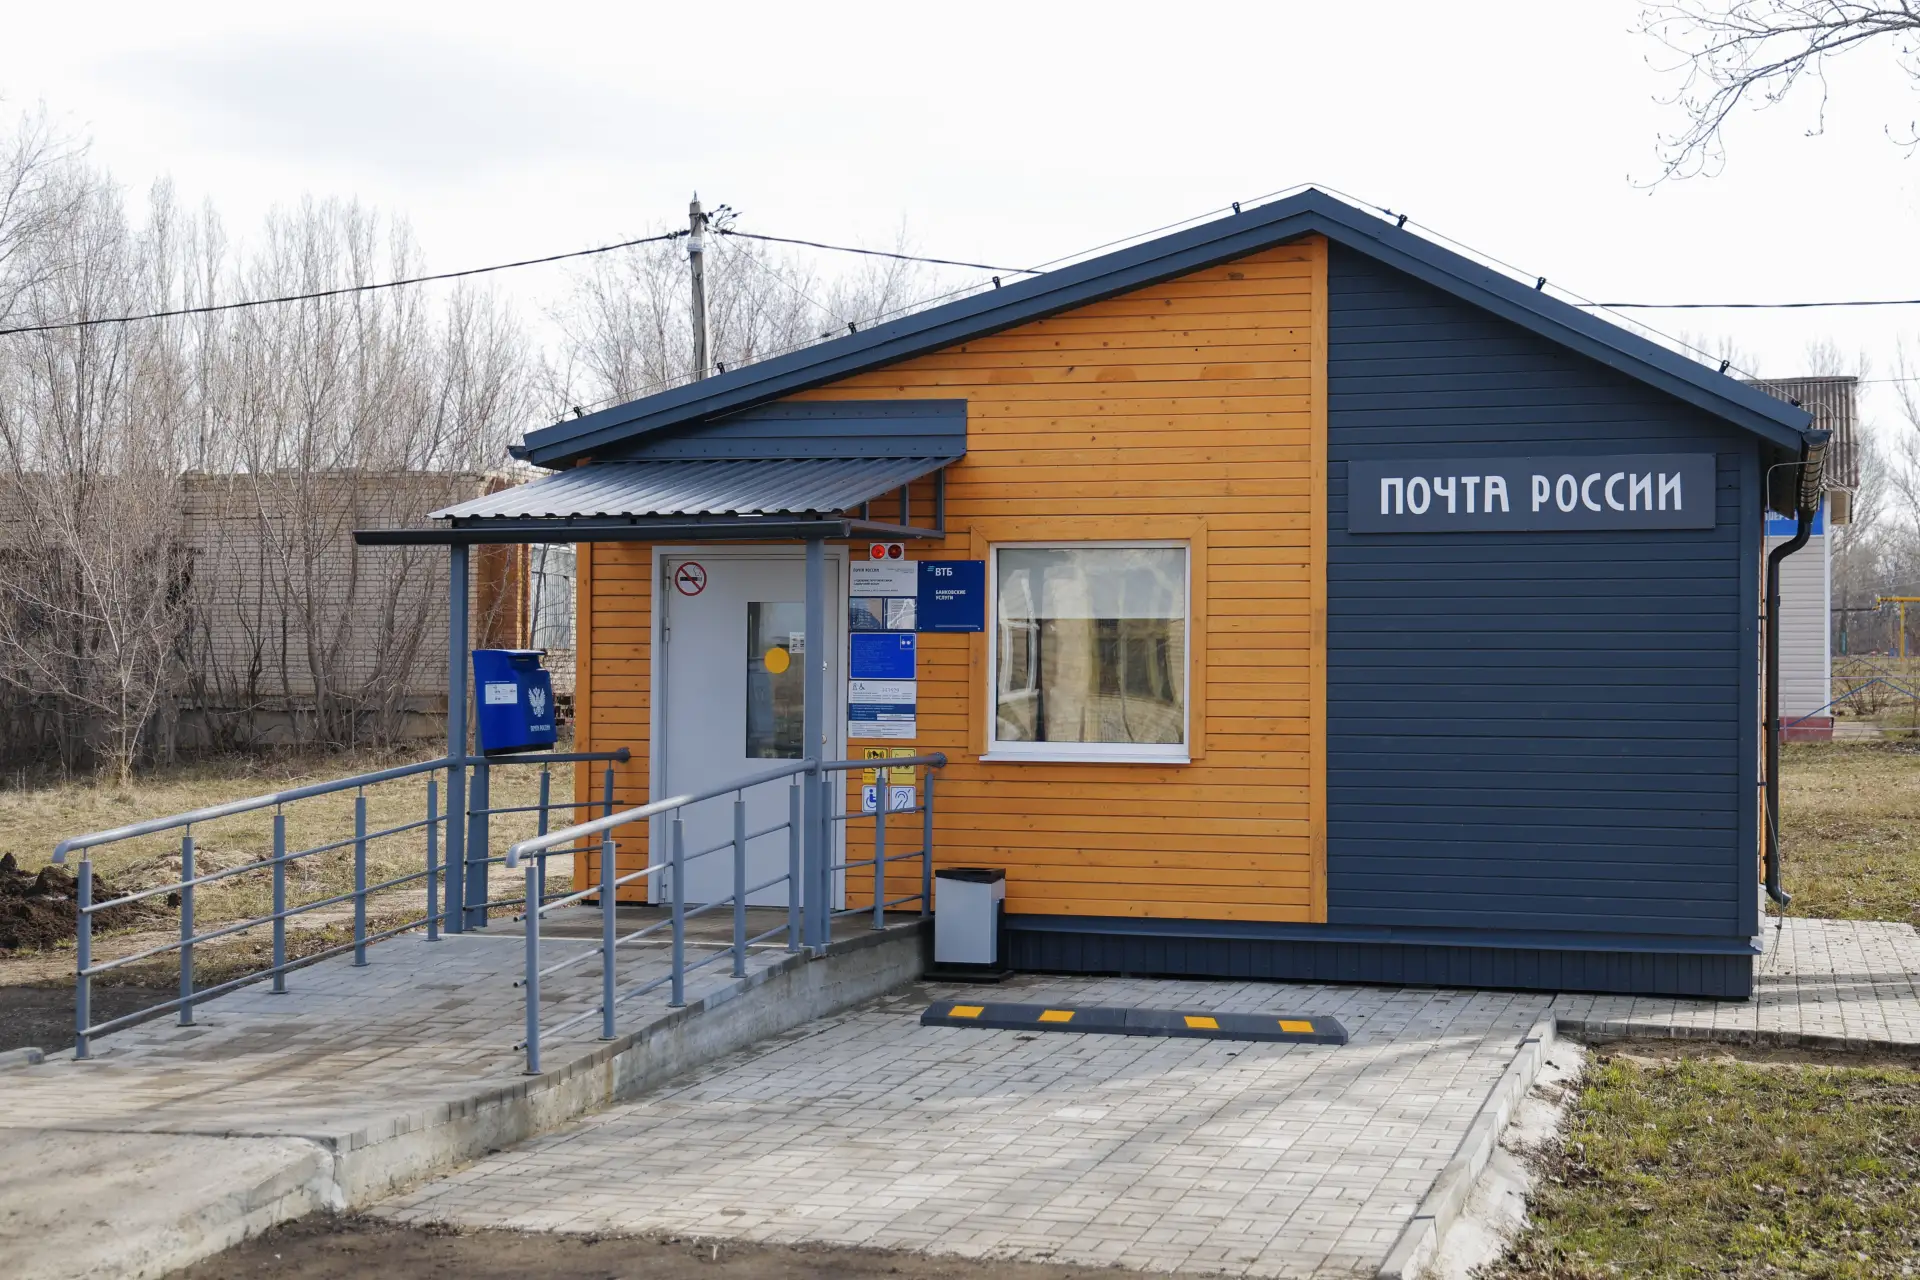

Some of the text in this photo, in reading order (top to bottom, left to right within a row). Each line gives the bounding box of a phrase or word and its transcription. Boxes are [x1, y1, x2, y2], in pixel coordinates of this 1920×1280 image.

[1380, 471, 1682, 515] ПОЧТА РОССИИ
[935, 567, 953, 577] ВТБ
